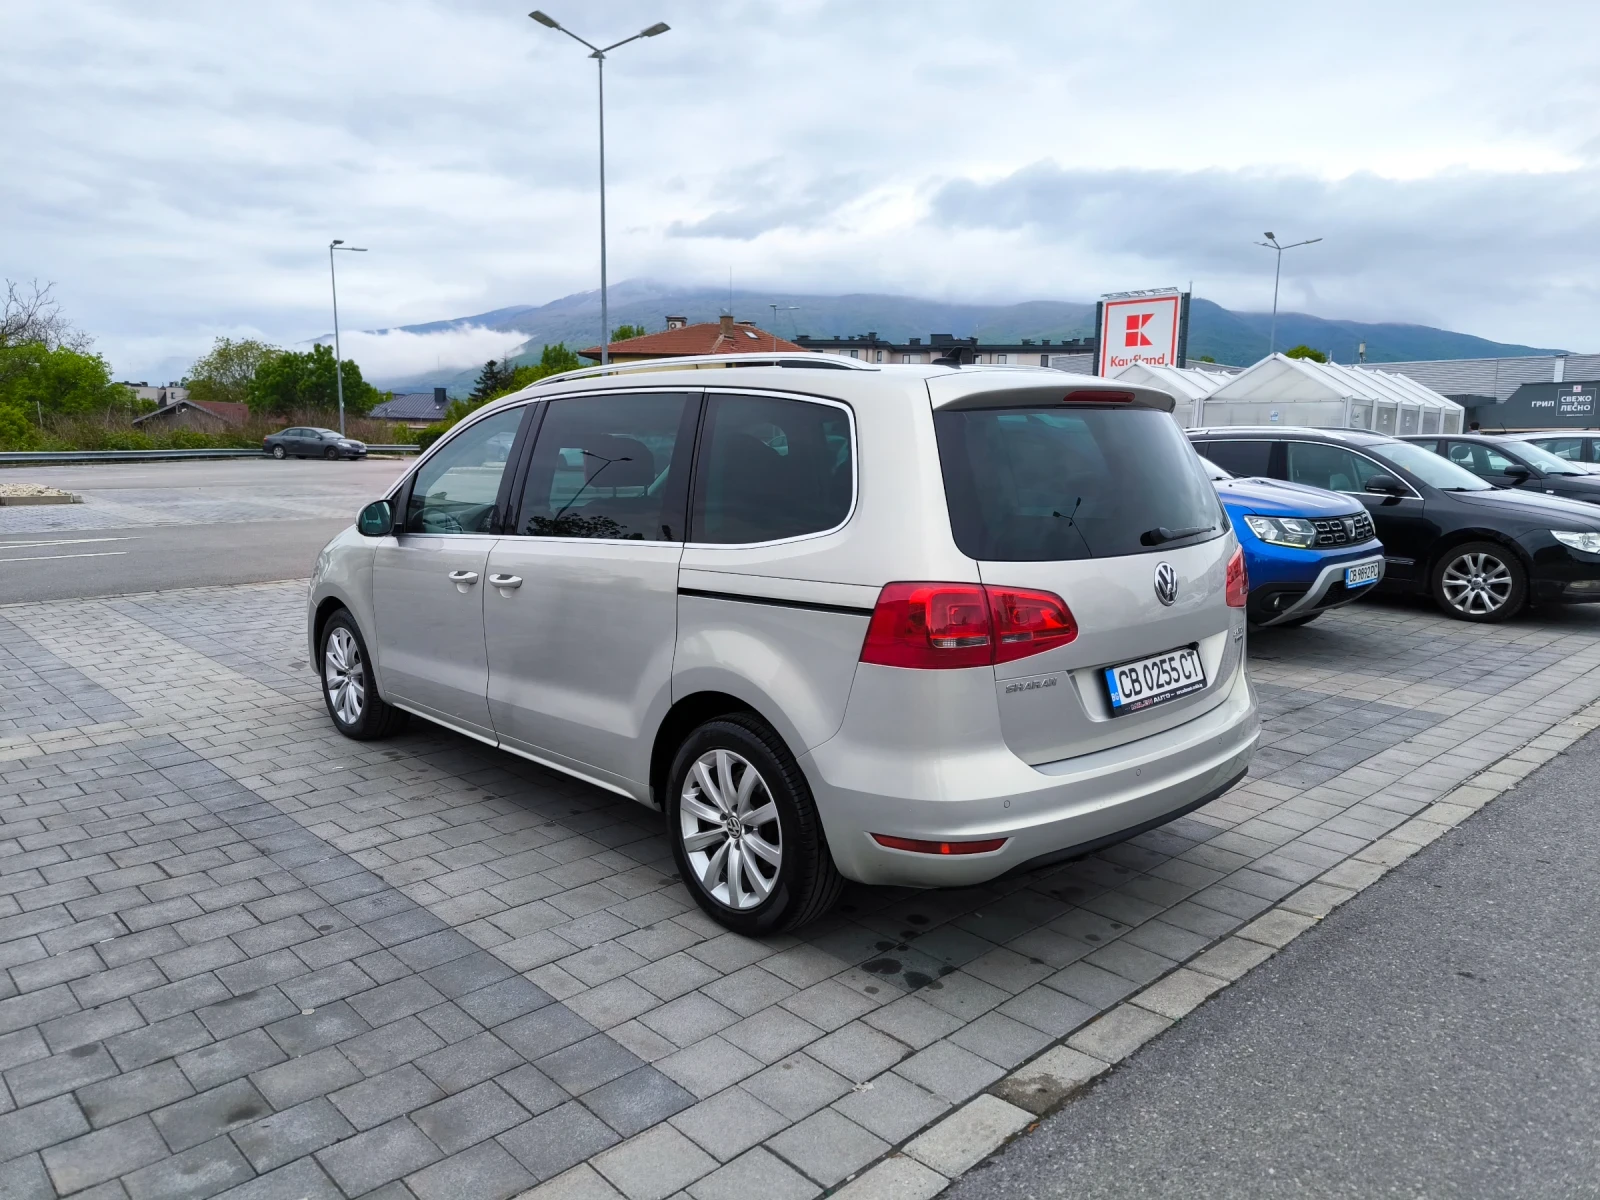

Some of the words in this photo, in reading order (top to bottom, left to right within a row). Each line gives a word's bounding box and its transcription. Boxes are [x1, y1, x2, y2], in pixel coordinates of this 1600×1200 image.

[1118, 667, 1143, 699] CB
[1143, 656, 1181, 692] 0255
[1179, 651, 1198, 680] CT
[1005, 677, 1058, 694] SHARAN
[1111, 693, 1120, 702] BG
[1153, 692, 1171, 704] AUTO
